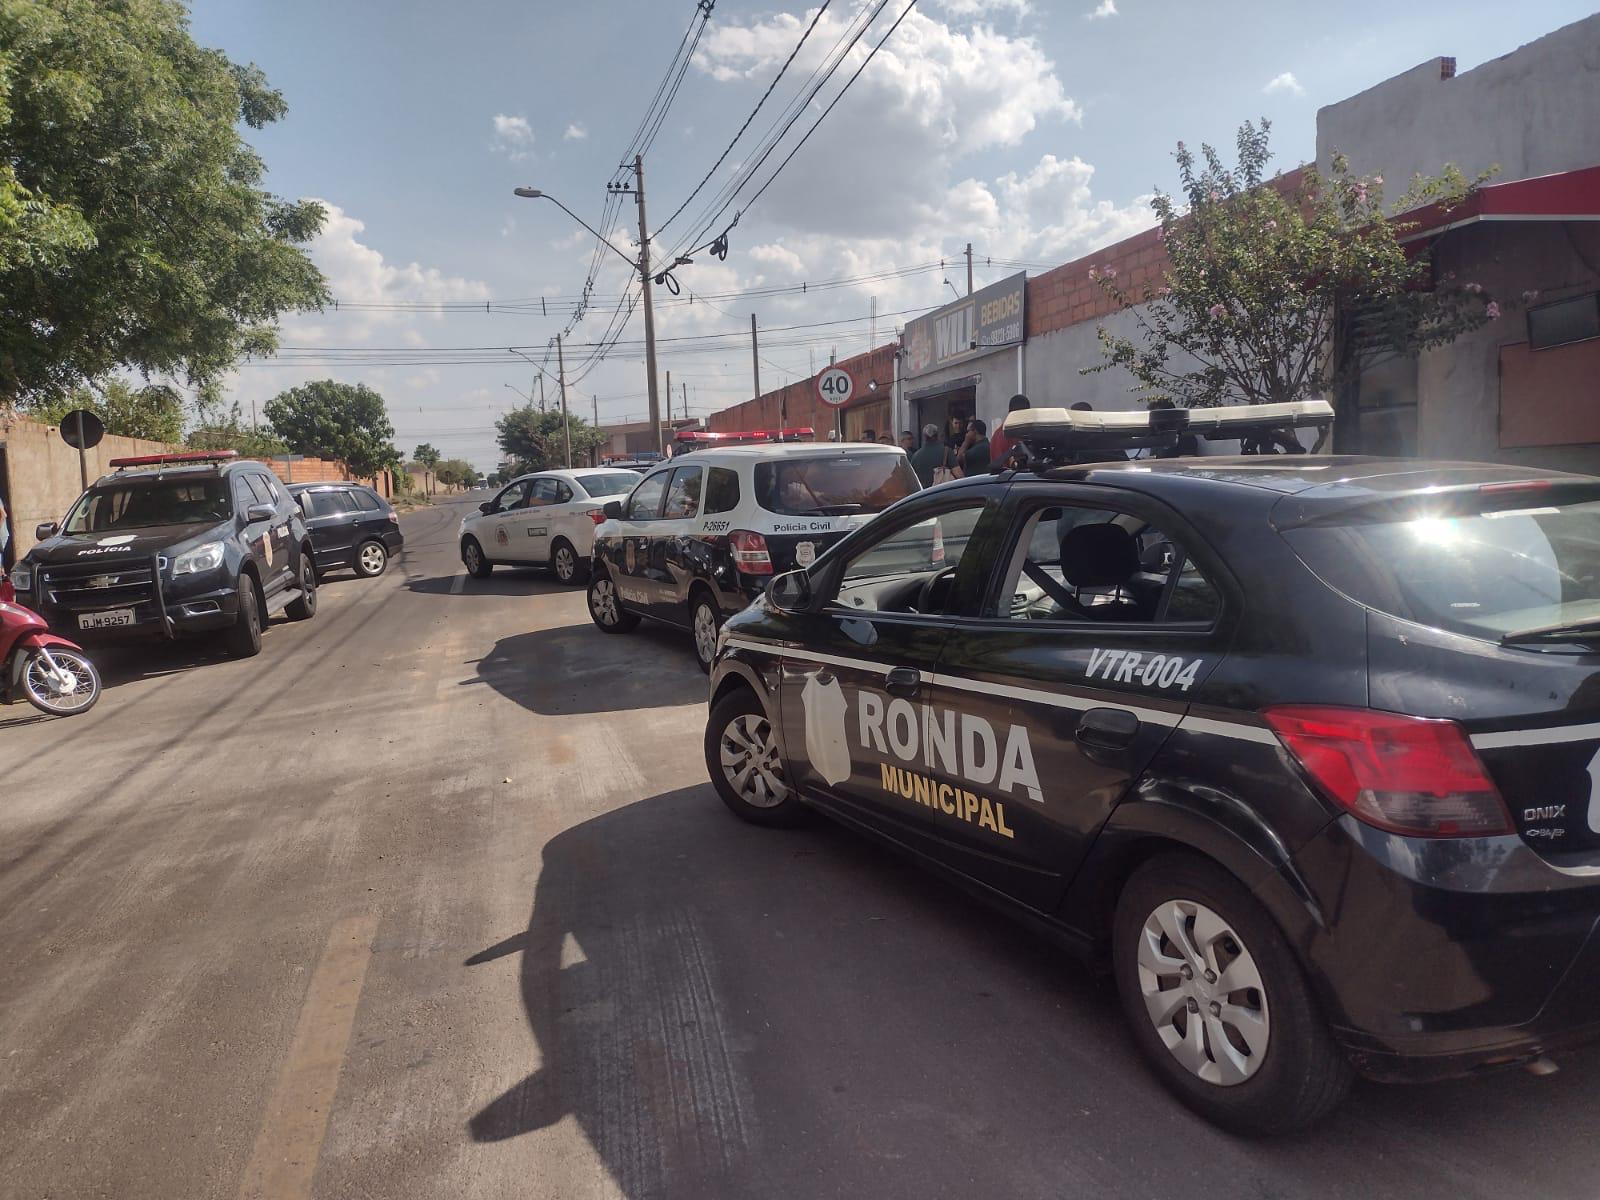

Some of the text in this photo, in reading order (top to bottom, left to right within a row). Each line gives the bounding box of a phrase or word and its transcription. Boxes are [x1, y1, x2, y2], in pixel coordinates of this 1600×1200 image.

[981, 290, 1020, 327] BEBIDAS
[821, 375, 849, 395] 40
[809, 521, 831, 531] Civil
[77, 545, 132, 556] POLÍCIA
[1084, 647, 1204, 692] VTR-004
[857, 689, 1046, 804] RONDA
[879, 762, 1015, 840] MUNICIPAL
[1524, 804, 1566, 821] ONIX
